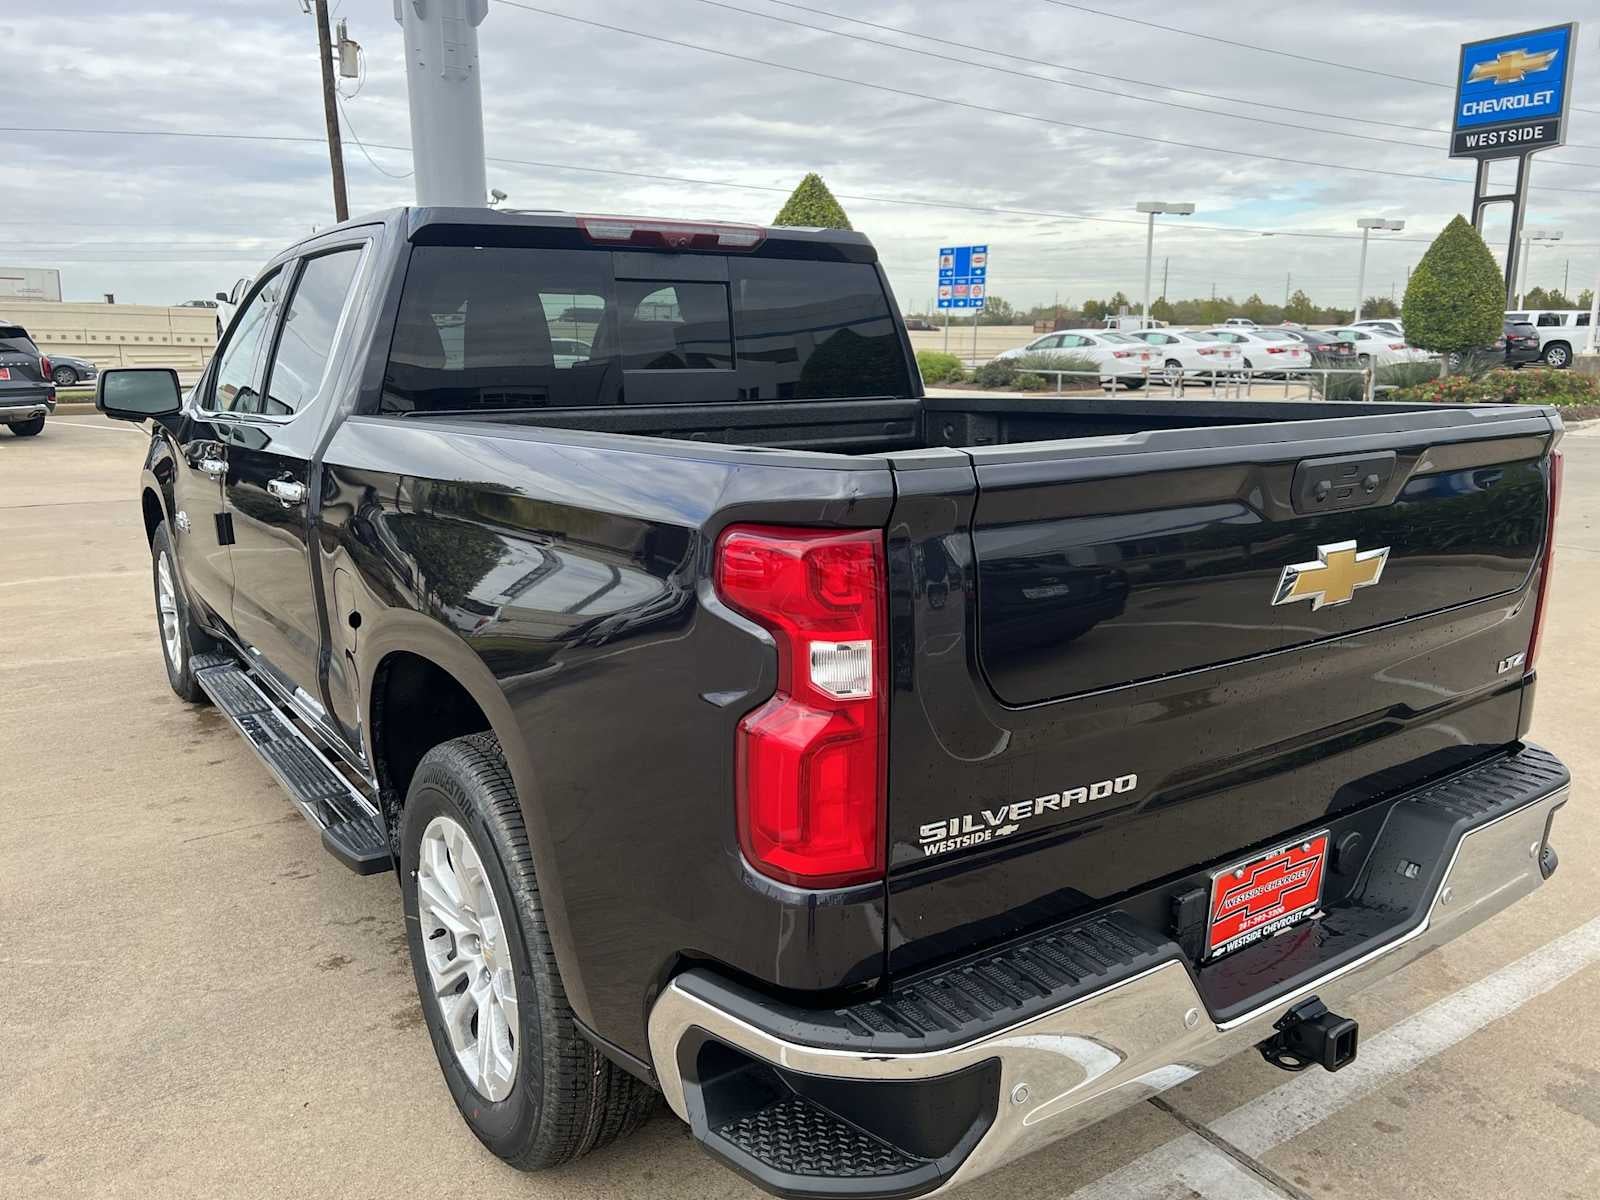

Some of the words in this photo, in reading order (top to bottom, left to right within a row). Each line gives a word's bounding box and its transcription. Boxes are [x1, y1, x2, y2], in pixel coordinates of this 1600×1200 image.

[1462, 90, 1555, 117] CHEVROLET
[1465, 126, 1544, 148] WESTSIDE
[1498, 652, 1525, 674] LTZ
[919, 773, 1138, 844] SILVERADO
[923, 829, 992, 857] WESTSIDE
[1224, 886, 1264, 909] WESTSIDE
[1264, 868, 1309, 894] CHEVROLET
[1226, 928, 1262, 953] WESTSIDE
[1262, 911, 1303, 936] CHEVROLET
